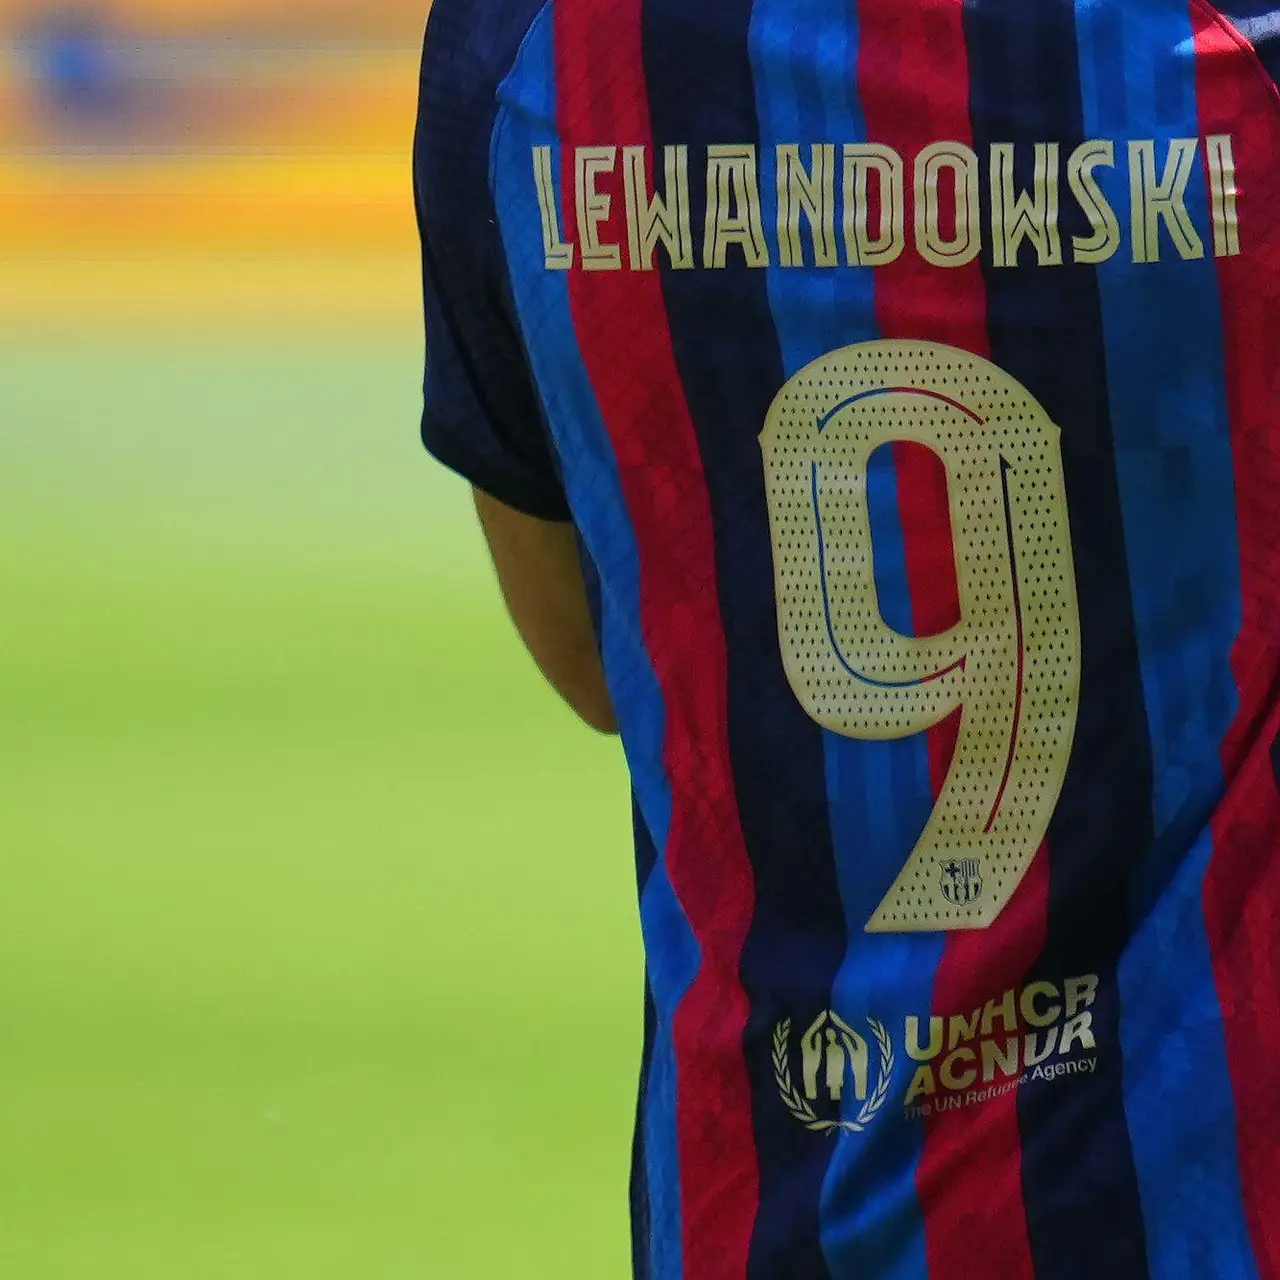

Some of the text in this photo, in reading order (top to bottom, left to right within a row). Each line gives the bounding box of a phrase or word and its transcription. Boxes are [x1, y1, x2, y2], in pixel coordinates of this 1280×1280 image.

[531, 133, 1242, 271] LEWANDOWSKI
[757, 338, 1082, 933] 9
[903, 1010, 1097, 1106] ACNUR
[904, 972, 1099, 1061] UNHCR
[934, 1094, 962, 1113] UN
[1031, 1056, 1098, 1081] Agency
